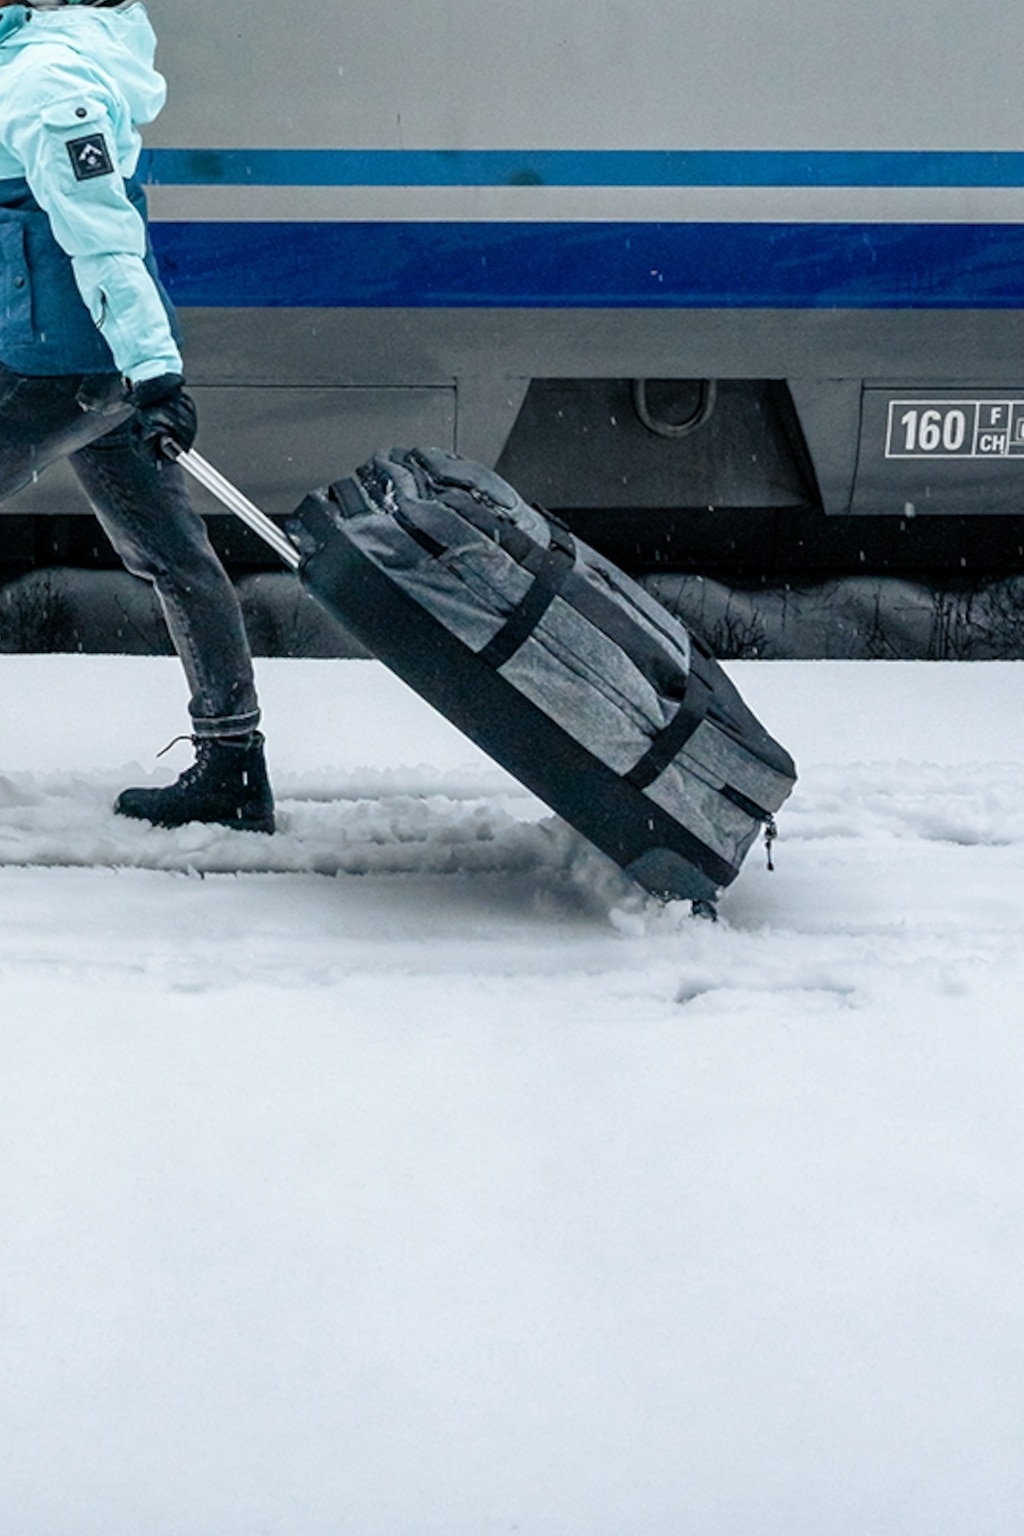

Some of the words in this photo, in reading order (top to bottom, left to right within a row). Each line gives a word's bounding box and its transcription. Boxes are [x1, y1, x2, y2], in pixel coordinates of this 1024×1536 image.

[990, 407, 1002, 425] F
[901, 409, 966, 451] 160
[979, 434, 1006, 452] CH
